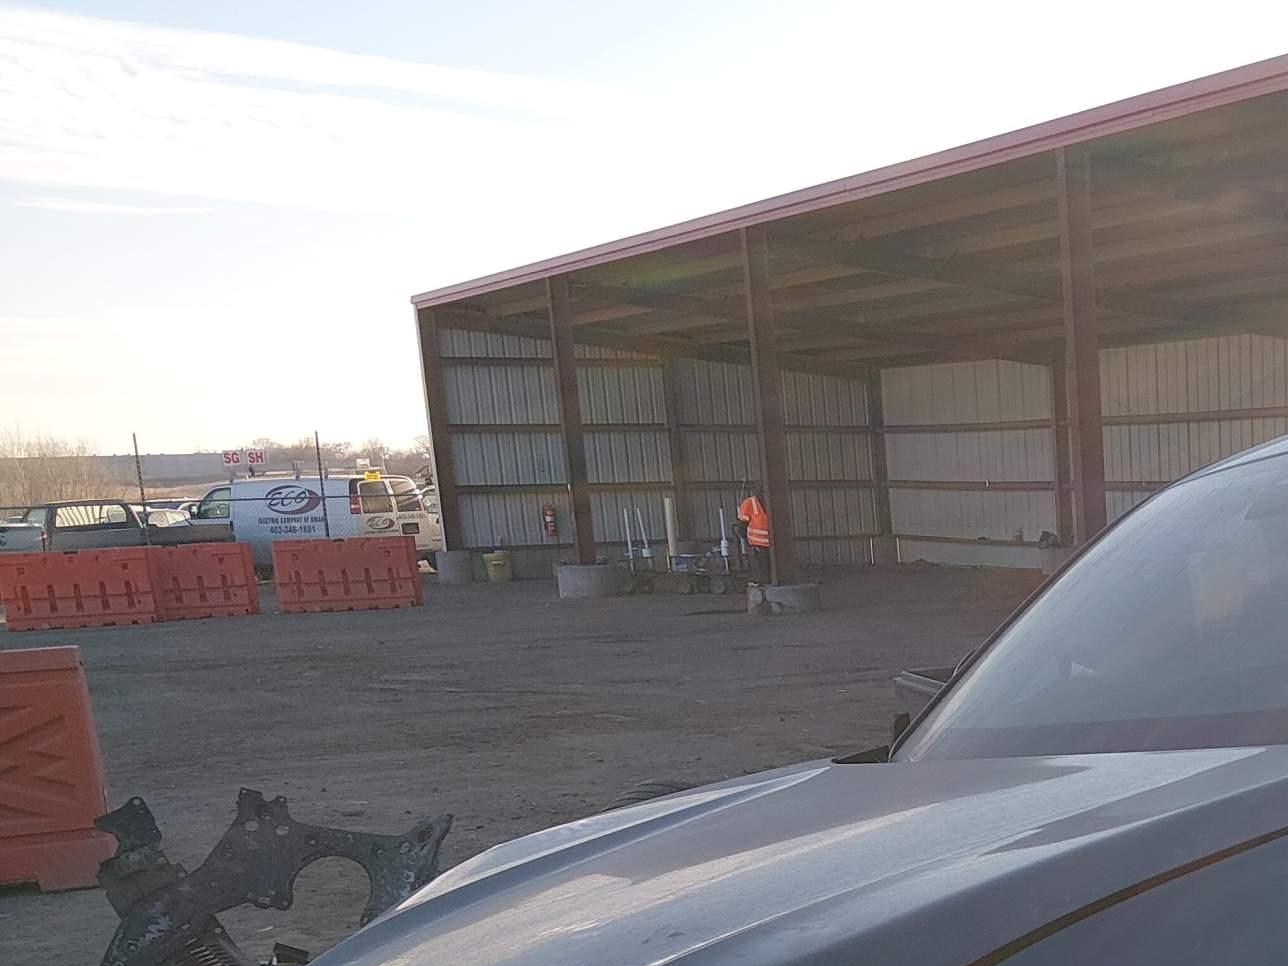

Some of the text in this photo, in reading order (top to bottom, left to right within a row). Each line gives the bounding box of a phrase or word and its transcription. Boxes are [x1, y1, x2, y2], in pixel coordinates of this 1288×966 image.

[224, 452, 240, 464] SG
[248, 452, 264, 463] SH
[269, 490, 307, 507] ECO
